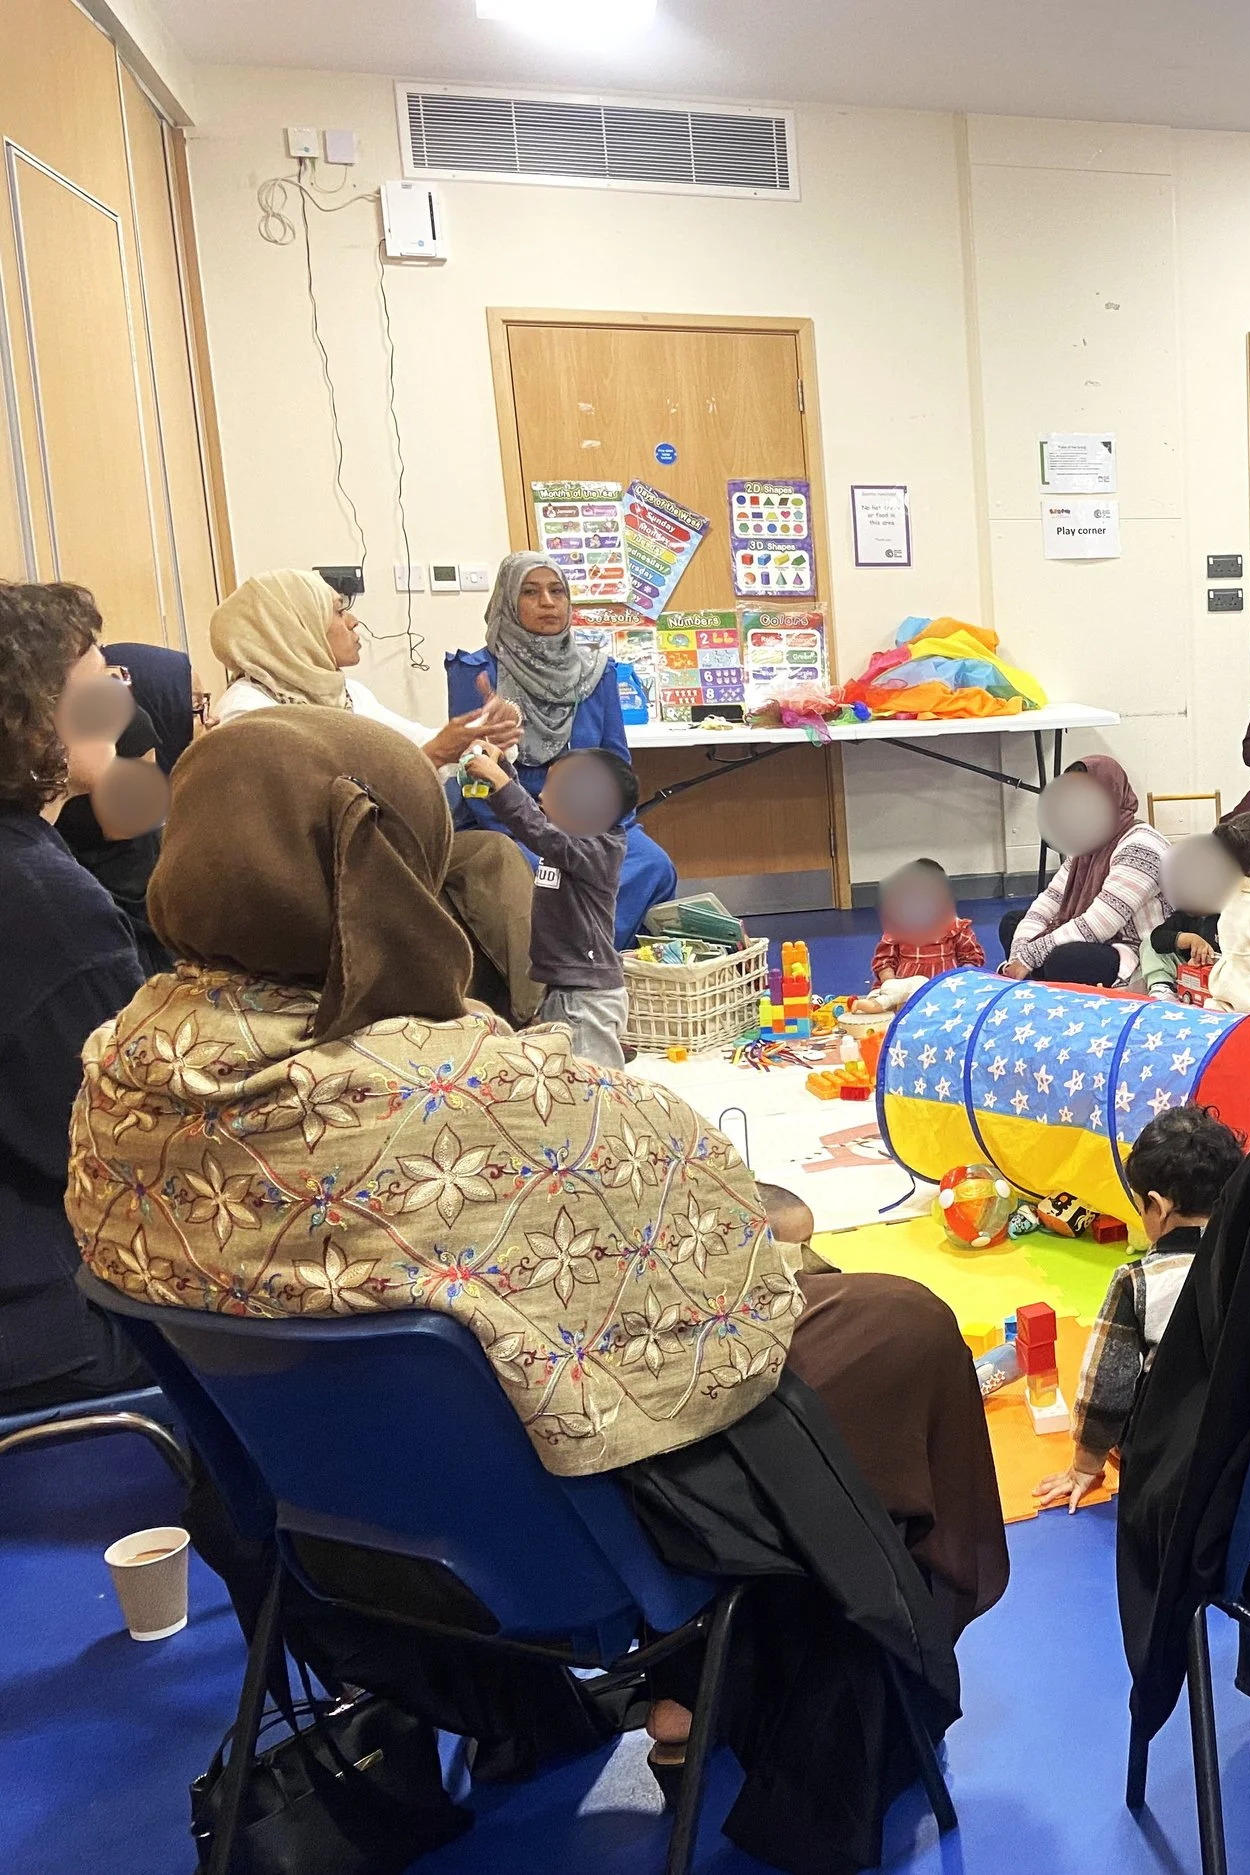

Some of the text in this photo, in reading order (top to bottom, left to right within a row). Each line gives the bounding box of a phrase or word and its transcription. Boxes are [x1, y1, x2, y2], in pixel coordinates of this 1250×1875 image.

[541, 489, 617, 498] Months of the Year
[746, 484, 793, 495] 2D Shapes
[635, 485, 701, 529] Days of the Week
[646, 512, 675, 533] Sunday
[1056, 526, 1107, 536] Play corner
[632, 533, 663, 555] Tuesday
[749, 541, 796, 552] 3D Shapes
[627, 547, 665, 572] ednesday
[586, 612, 640, 623] Seasons
[668, 615, 720, 627] Numbers
[760, 614, 809, 626] Colors
[657, 635, 663, 645] 1
[699, 632, 710, 645] 2
[702, 652, 710, 664] 4
[661, 673, 670, 684] 5
[704, 670, 713, 682] 6
[663, 690, 672, 702] 7
[705, 687, 715, 699] 8
